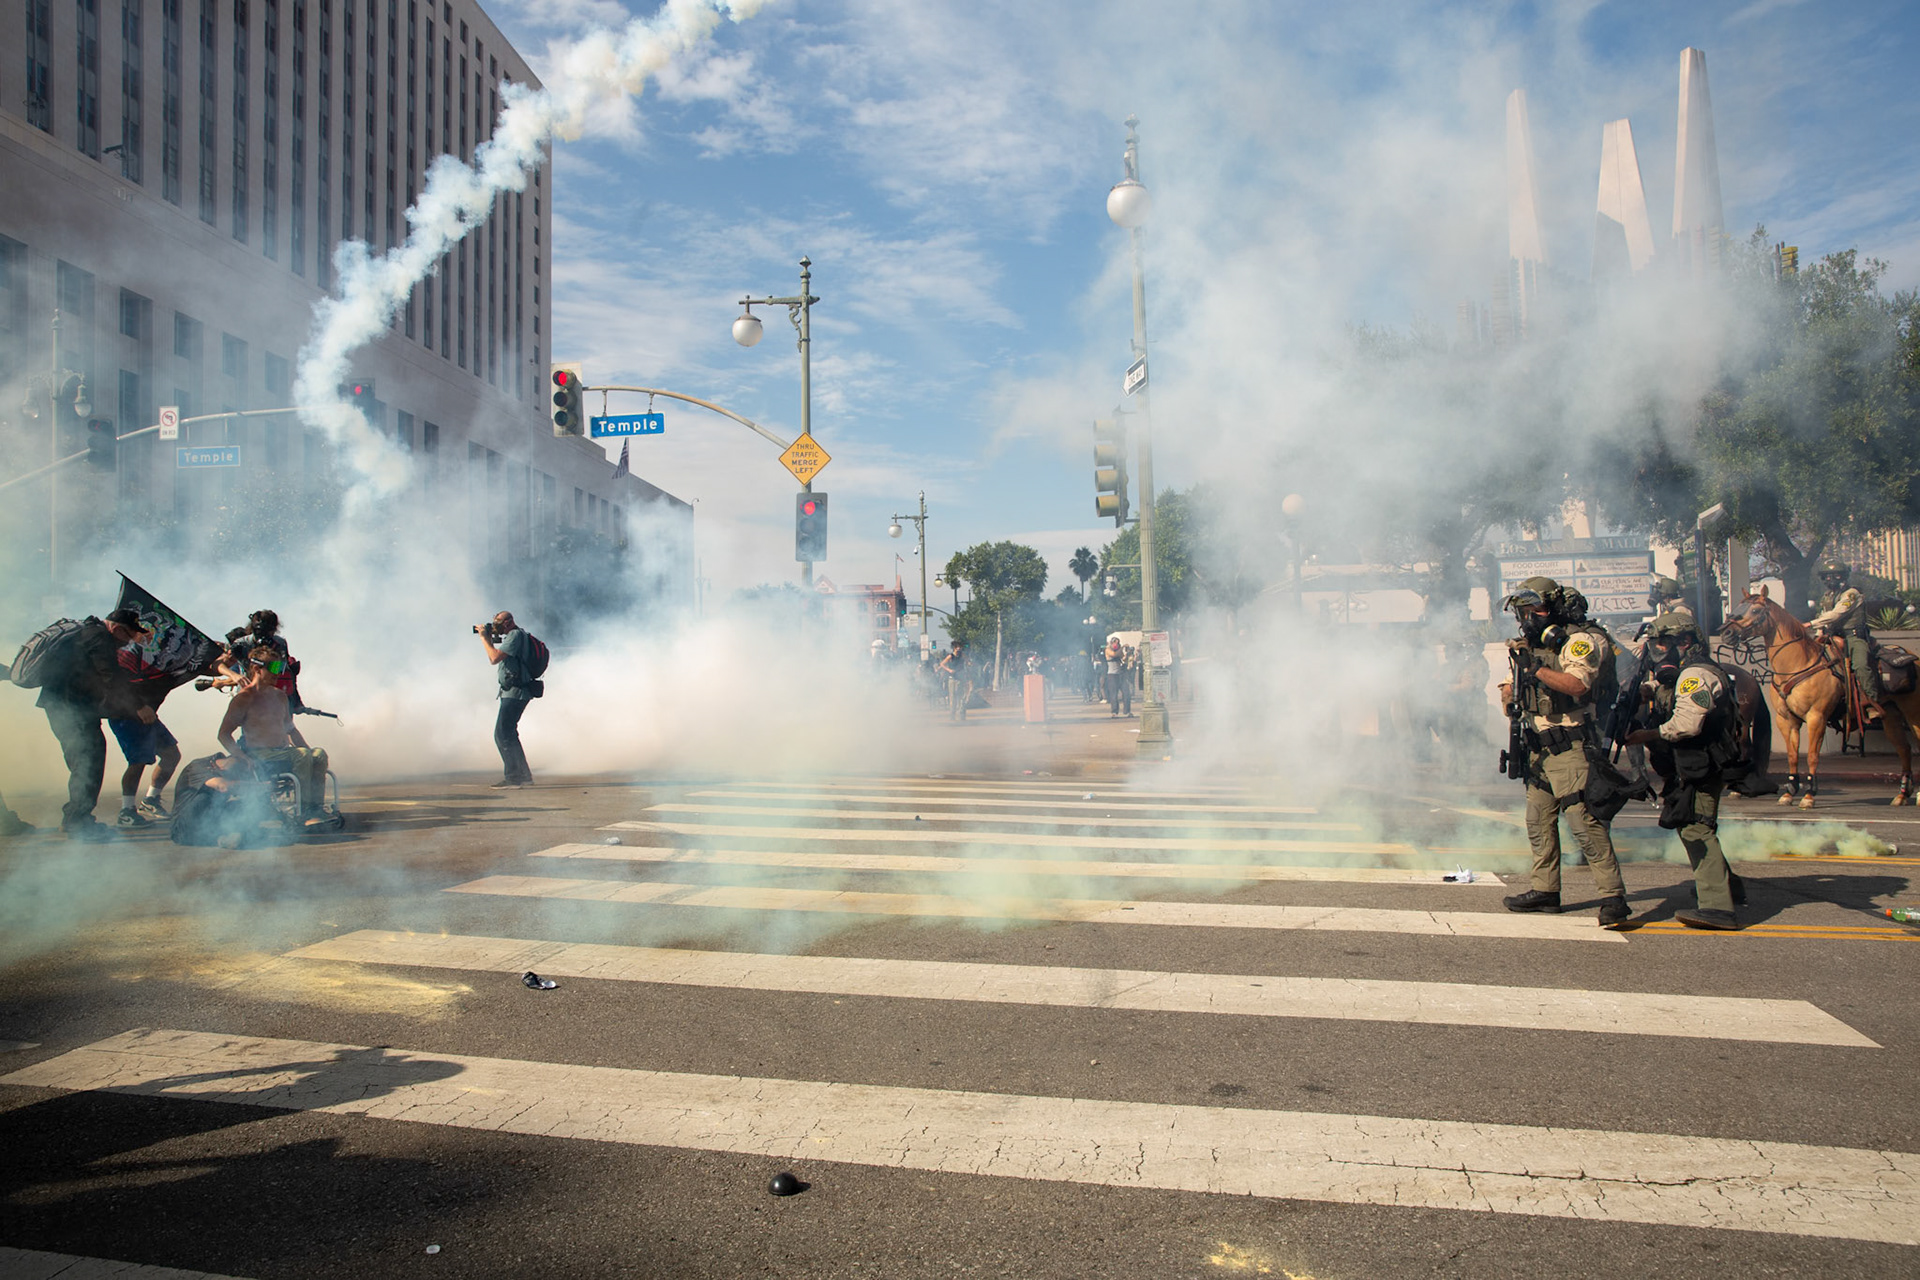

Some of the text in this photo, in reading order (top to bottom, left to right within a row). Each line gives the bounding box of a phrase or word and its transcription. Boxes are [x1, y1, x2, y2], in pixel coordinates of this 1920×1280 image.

[598, 418, 658, 434] Temple
[184, 451, 233, 464] Temple
[1602, 537, 1641, 550] MALL
[1512, 561, 1533, 569] FOOD
[1533, 568, 1569, 576] SERVICES
[1587, 597, 1641, 612] UCK ICE
